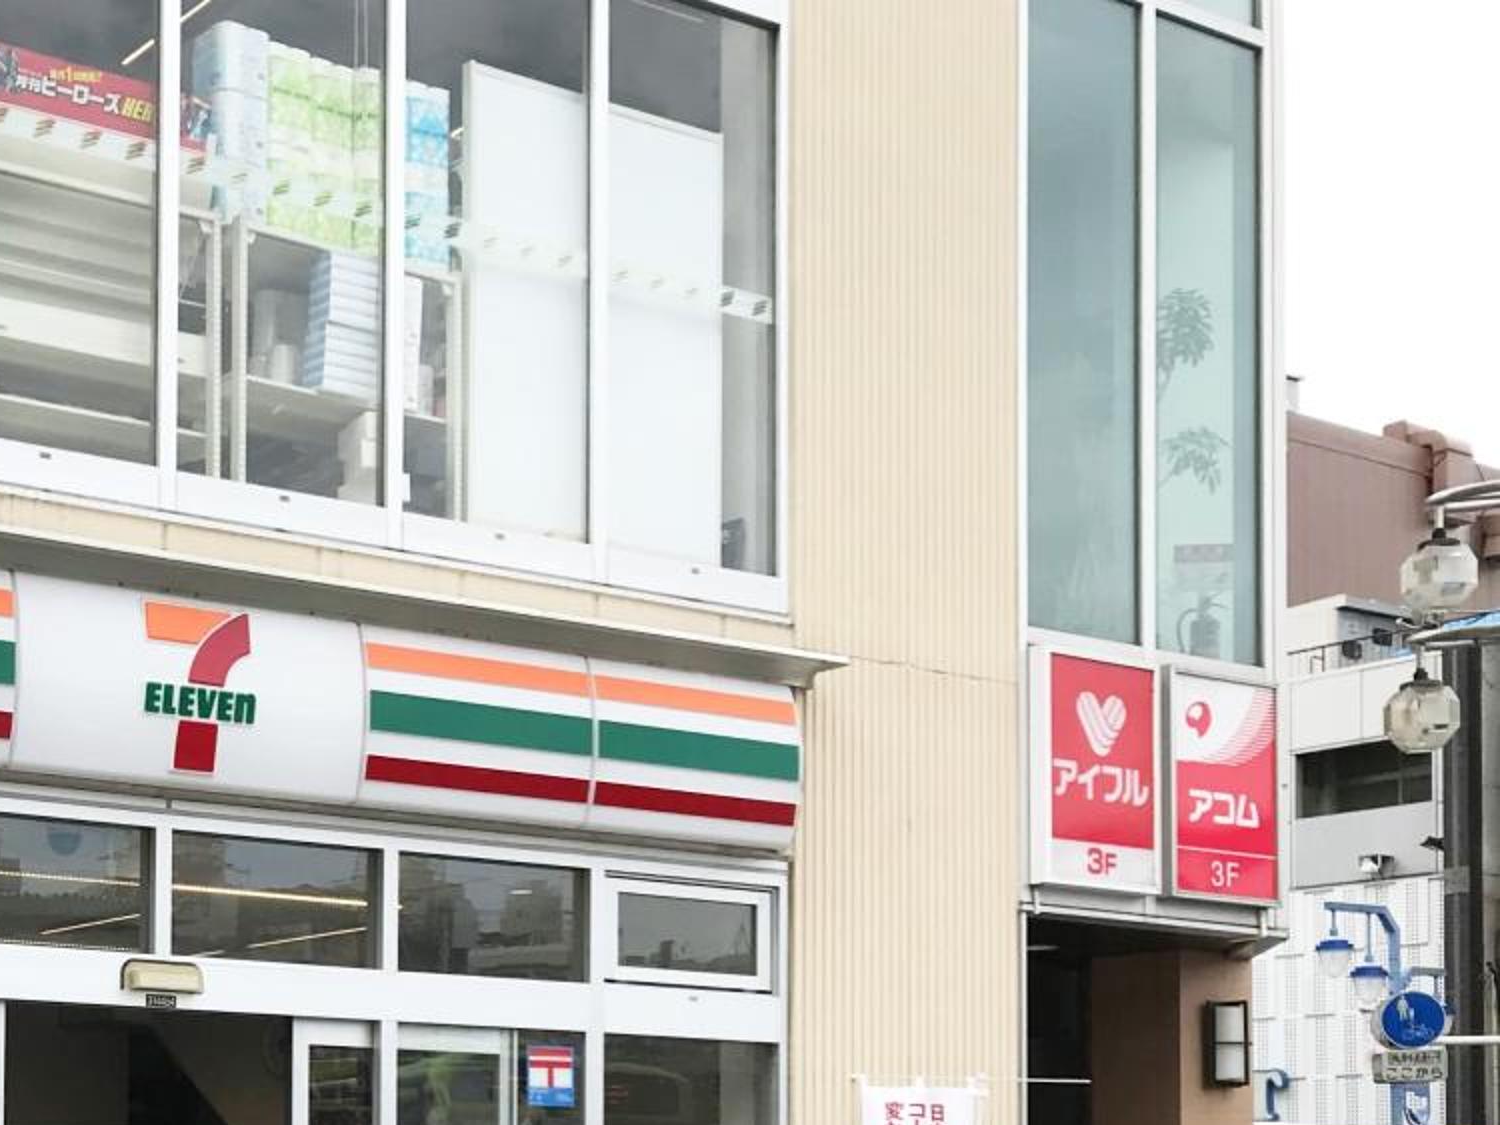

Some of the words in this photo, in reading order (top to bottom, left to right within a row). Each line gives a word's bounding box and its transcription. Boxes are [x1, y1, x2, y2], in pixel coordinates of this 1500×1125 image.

[1052, 757, 1150, 808] アイフル
[1188, 787, 1261, 829] アコム
[1087, 847, 1118, 876] 3F
[1211, 860, 1241, 888] 3F
[1386, 1067, 1443, 1079] ここから
